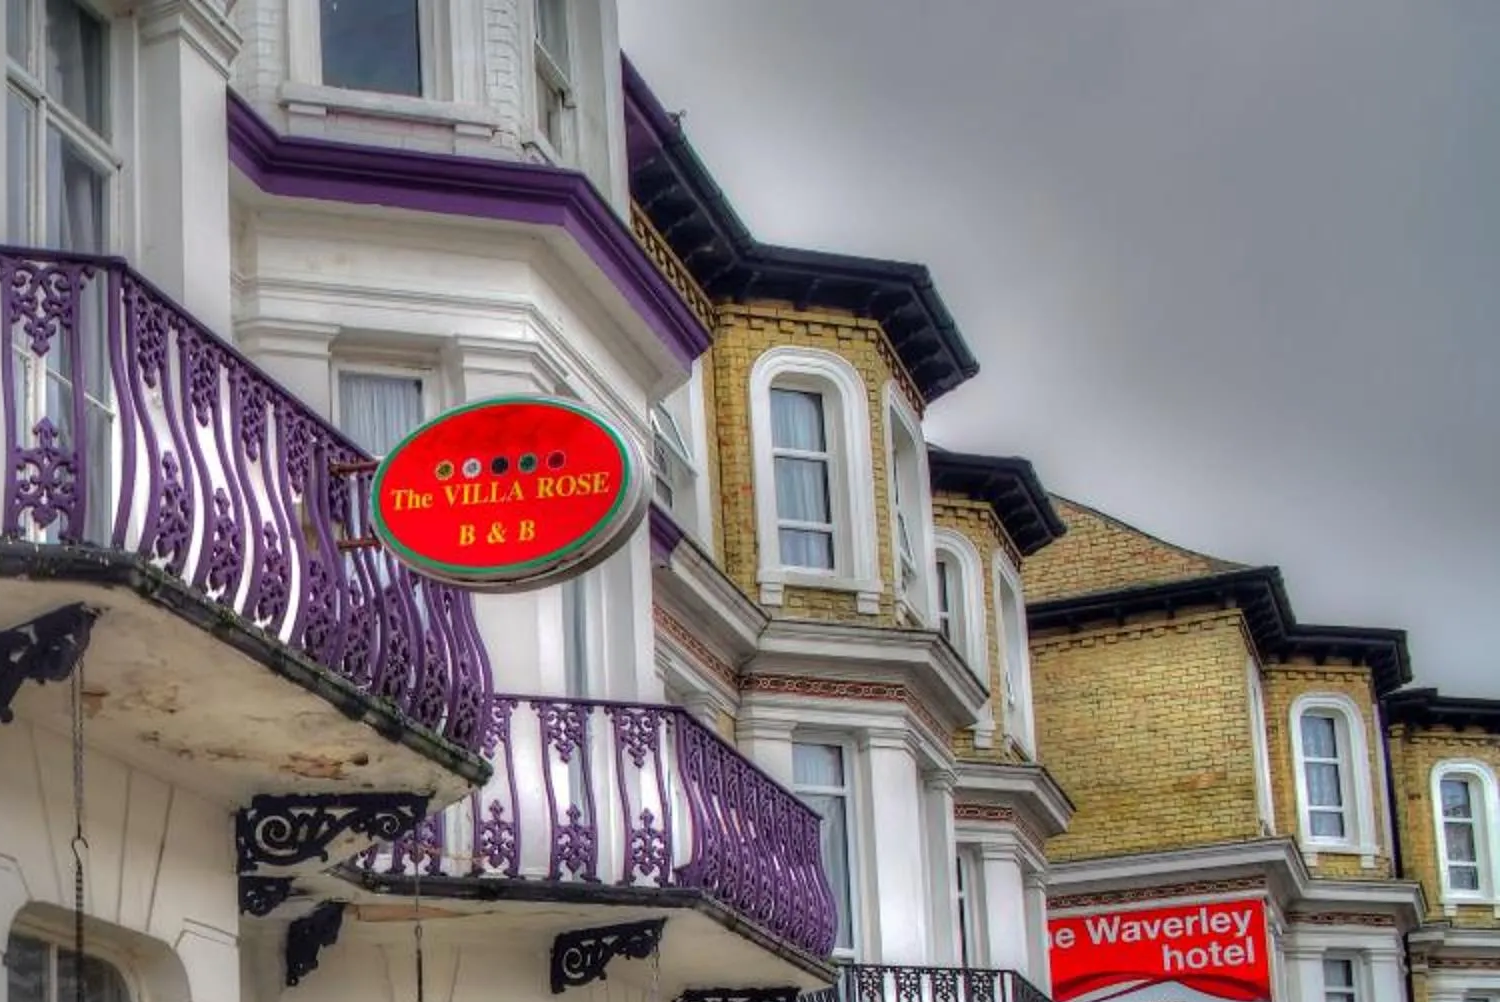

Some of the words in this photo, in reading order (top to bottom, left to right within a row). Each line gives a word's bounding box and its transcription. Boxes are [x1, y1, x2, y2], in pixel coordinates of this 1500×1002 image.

[391, 489, 433, 511] The
[443, 480, 525, 506] VILLA
[535, 472, 610, 500] ROSE
[458, 524, 476, 546] B
[487, 522, 506, 544] &
[518, 519, 535, 541] B
[1047, 927, 1076, 949] e
[1085, 907, 1253, 946] Waverley
[1161, 937, 1256, 971] hotel
